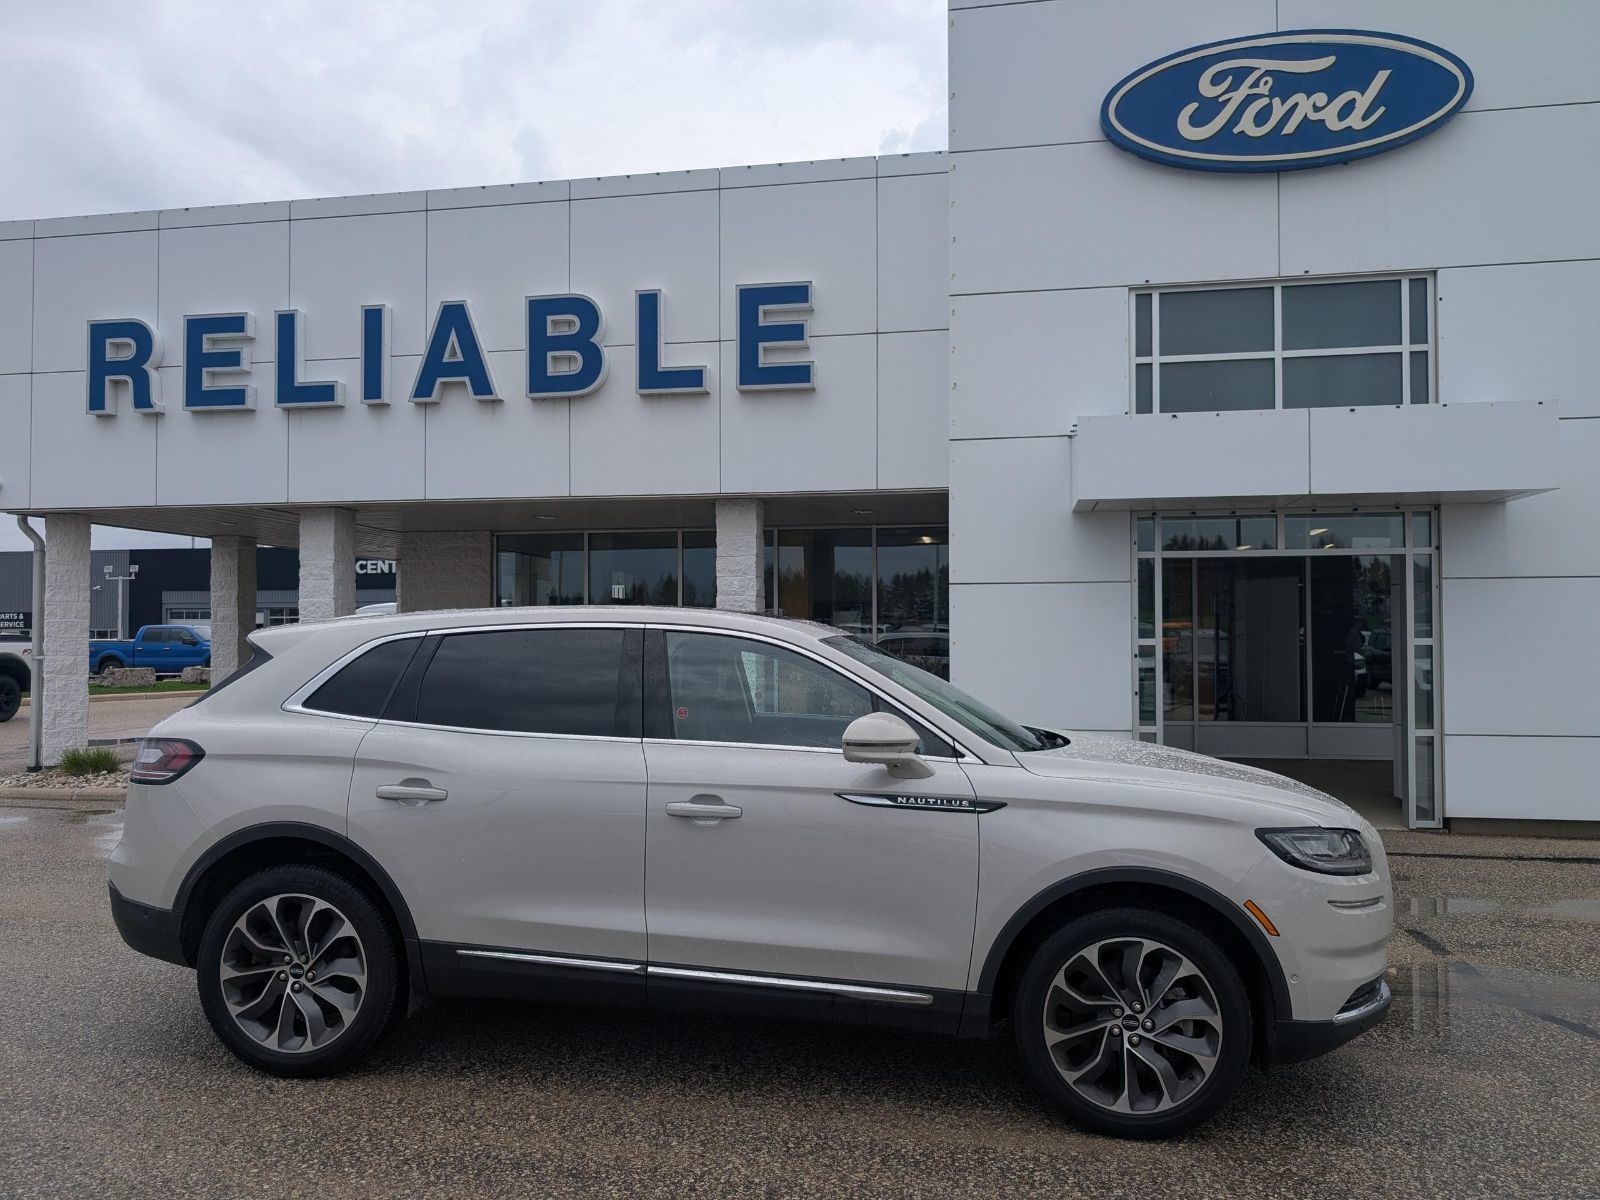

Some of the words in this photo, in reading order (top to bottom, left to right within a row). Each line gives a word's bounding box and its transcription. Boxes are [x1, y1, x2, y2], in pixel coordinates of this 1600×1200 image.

[1177, 55, 1392, 141] Ford
[86, 281, 816, 416] RELIABLE
[897, 797, 970, 807] NAUTILUS
